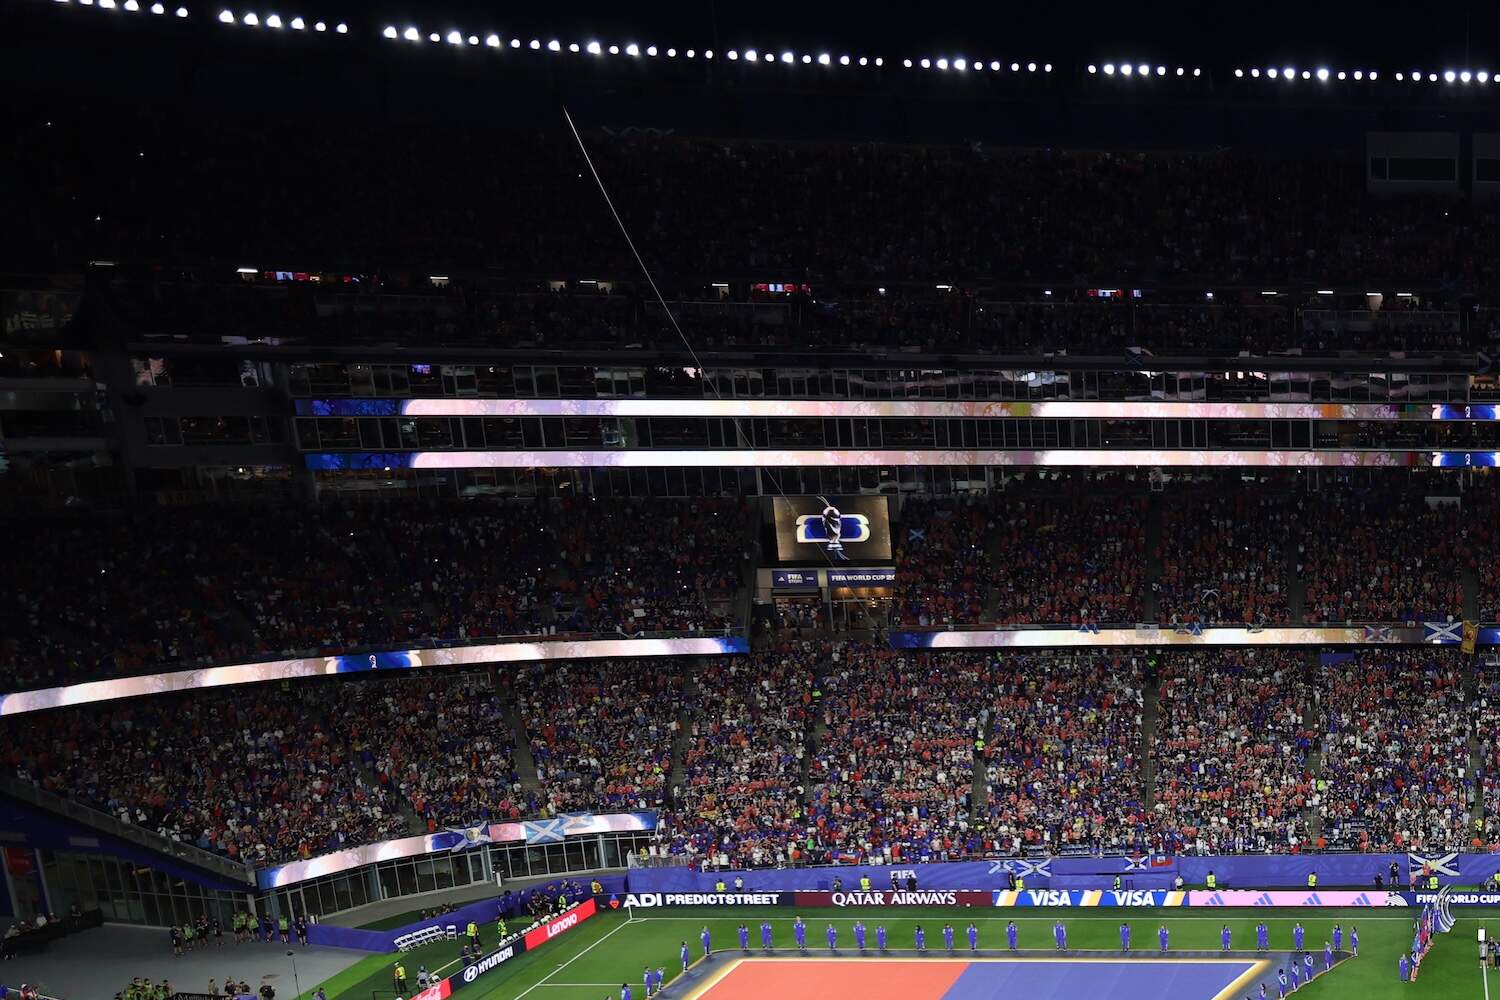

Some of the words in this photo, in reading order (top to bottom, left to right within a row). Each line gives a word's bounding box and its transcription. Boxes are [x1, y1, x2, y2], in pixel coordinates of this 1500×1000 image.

[624, 894, 663, 907] ADI
[666, 894, 779, 906] PREDICTSTREET
[832, 893, 885, 907] QATAR
[891, 893, 957, 906] AIRWAYS
[1031, 891, 1071, 906] VISA
[1115, 891, 1155, 906] VISA
[1444, 895, 1479, 904] ORLD
[1480, 895, 1500, 904] CUP
[546, 912, 578, 937] Lenovo
[478, 946, 514, 974] HYUNDAI
